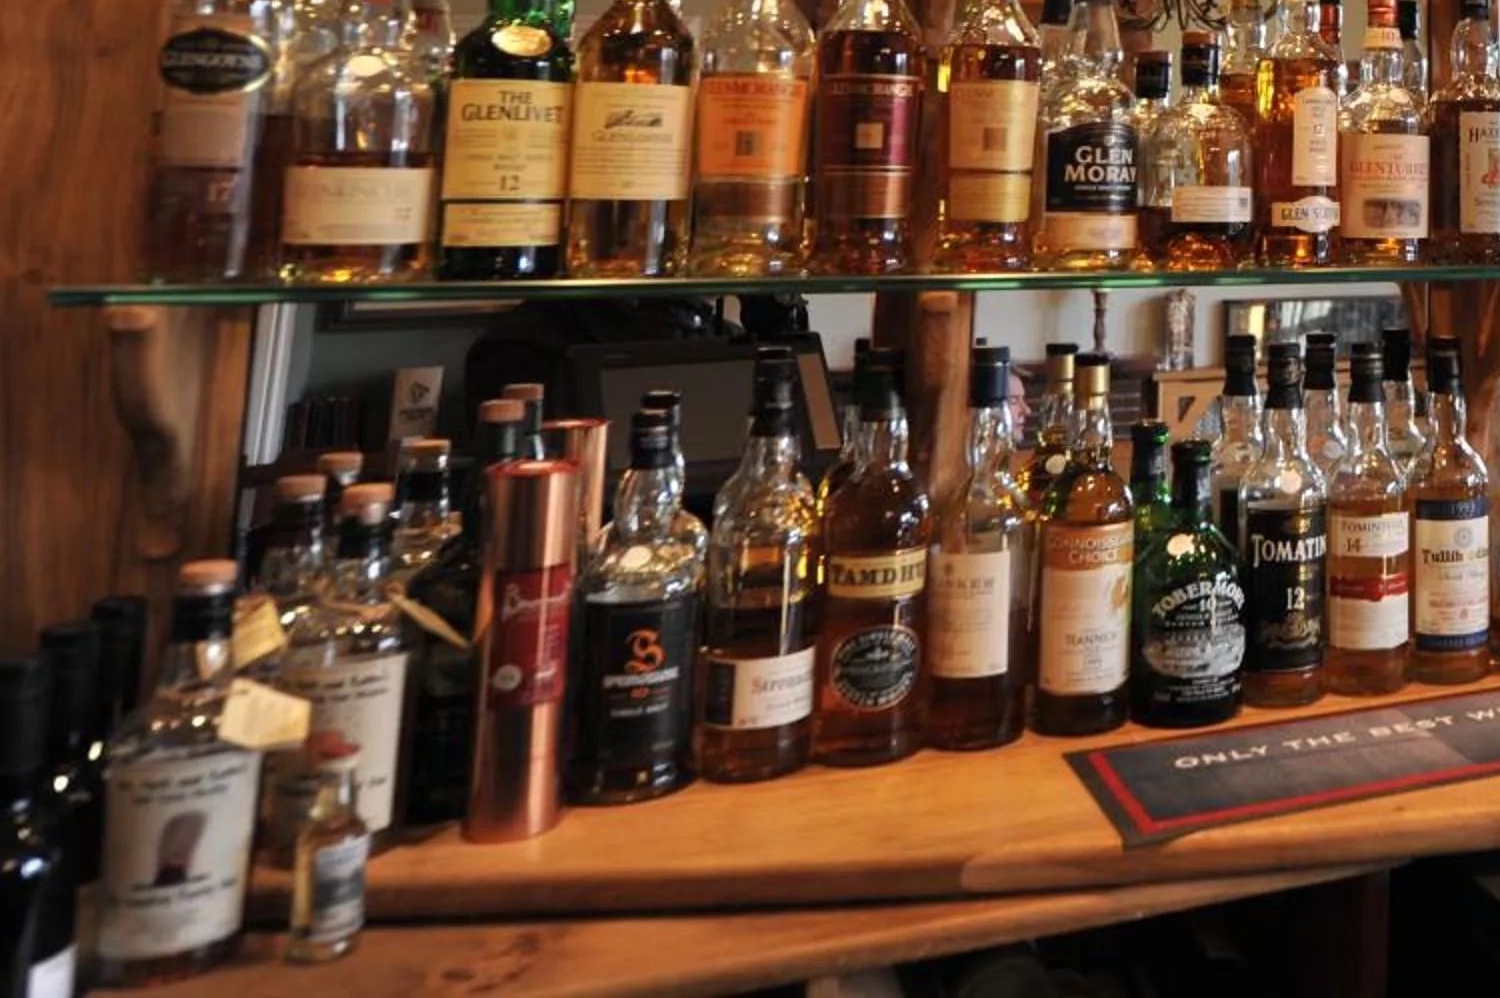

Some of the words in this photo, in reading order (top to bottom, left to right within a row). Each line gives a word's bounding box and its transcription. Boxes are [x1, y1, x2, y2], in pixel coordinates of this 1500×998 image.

[499, 89, 533, 105] THE
[461, 102, 566, 124] GLENLIVET
[1075, 146, 1133, 166] GLEN
[499, 174, 521, 191] 12
[1063, 165, 1137, 185] MORAY
[1251, 533, 1327, 568] TOMATIN
[831, 559, 926, 588] TAMDHU
[1286, 585, 1305, 611] 12
[1173, 744, 1267, 769] ONLY
[1281, 731, 1357, 752] THE
[1368, 714, 1454, 739] BEST
